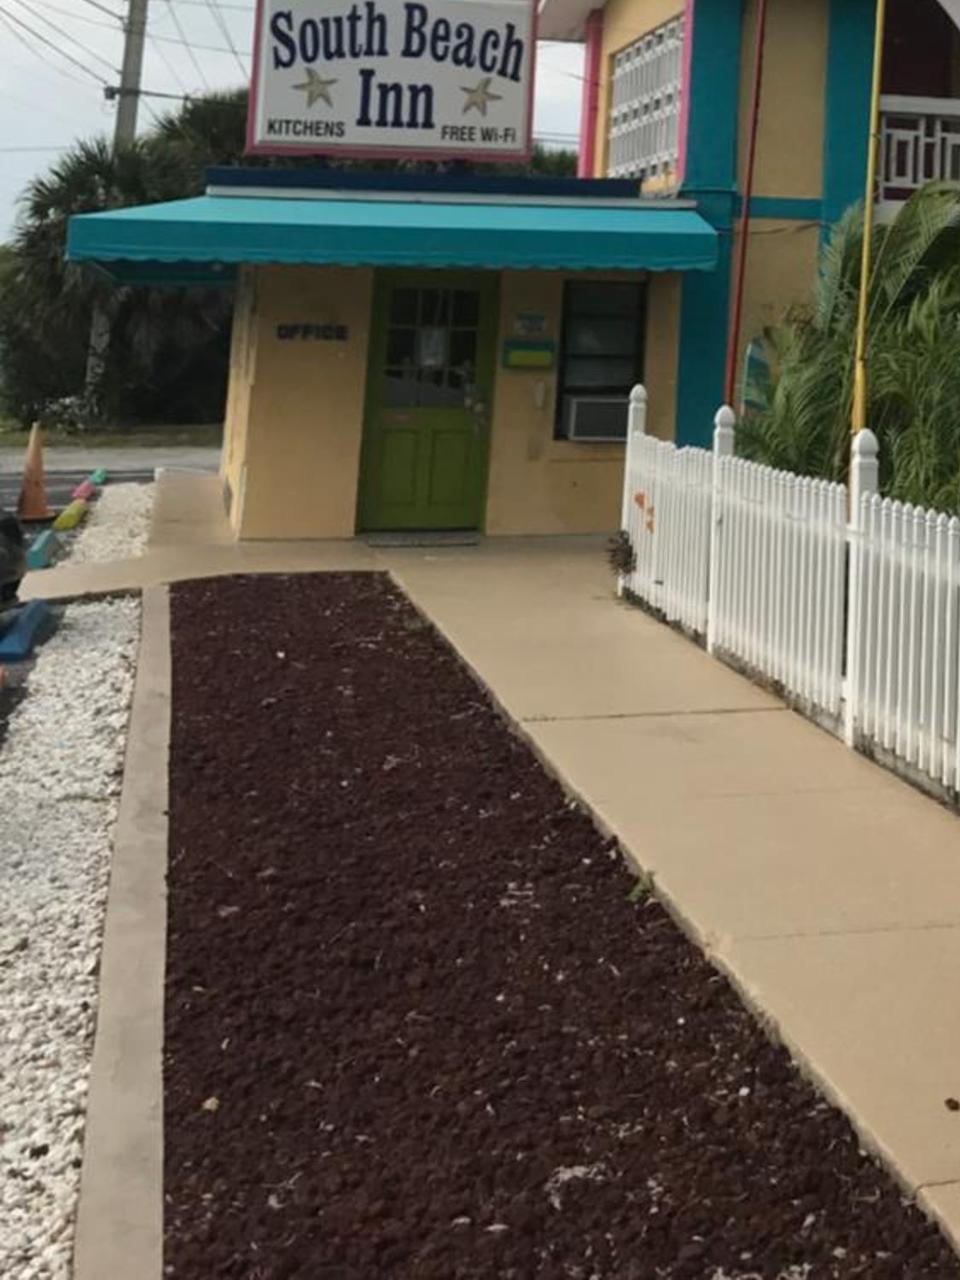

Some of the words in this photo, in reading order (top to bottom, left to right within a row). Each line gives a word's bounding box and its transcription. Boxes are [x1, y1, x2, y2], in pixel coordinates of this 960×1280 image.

[270, 1, 389, 70] South
[401, 2, 524, 83] Beach
[355, 68, 435, 129] Inn
[267, 119, 346, 138] KITCHENS
[441, 125, 476, 142] FREE
[277, 323, 348, 341] OFFICE
